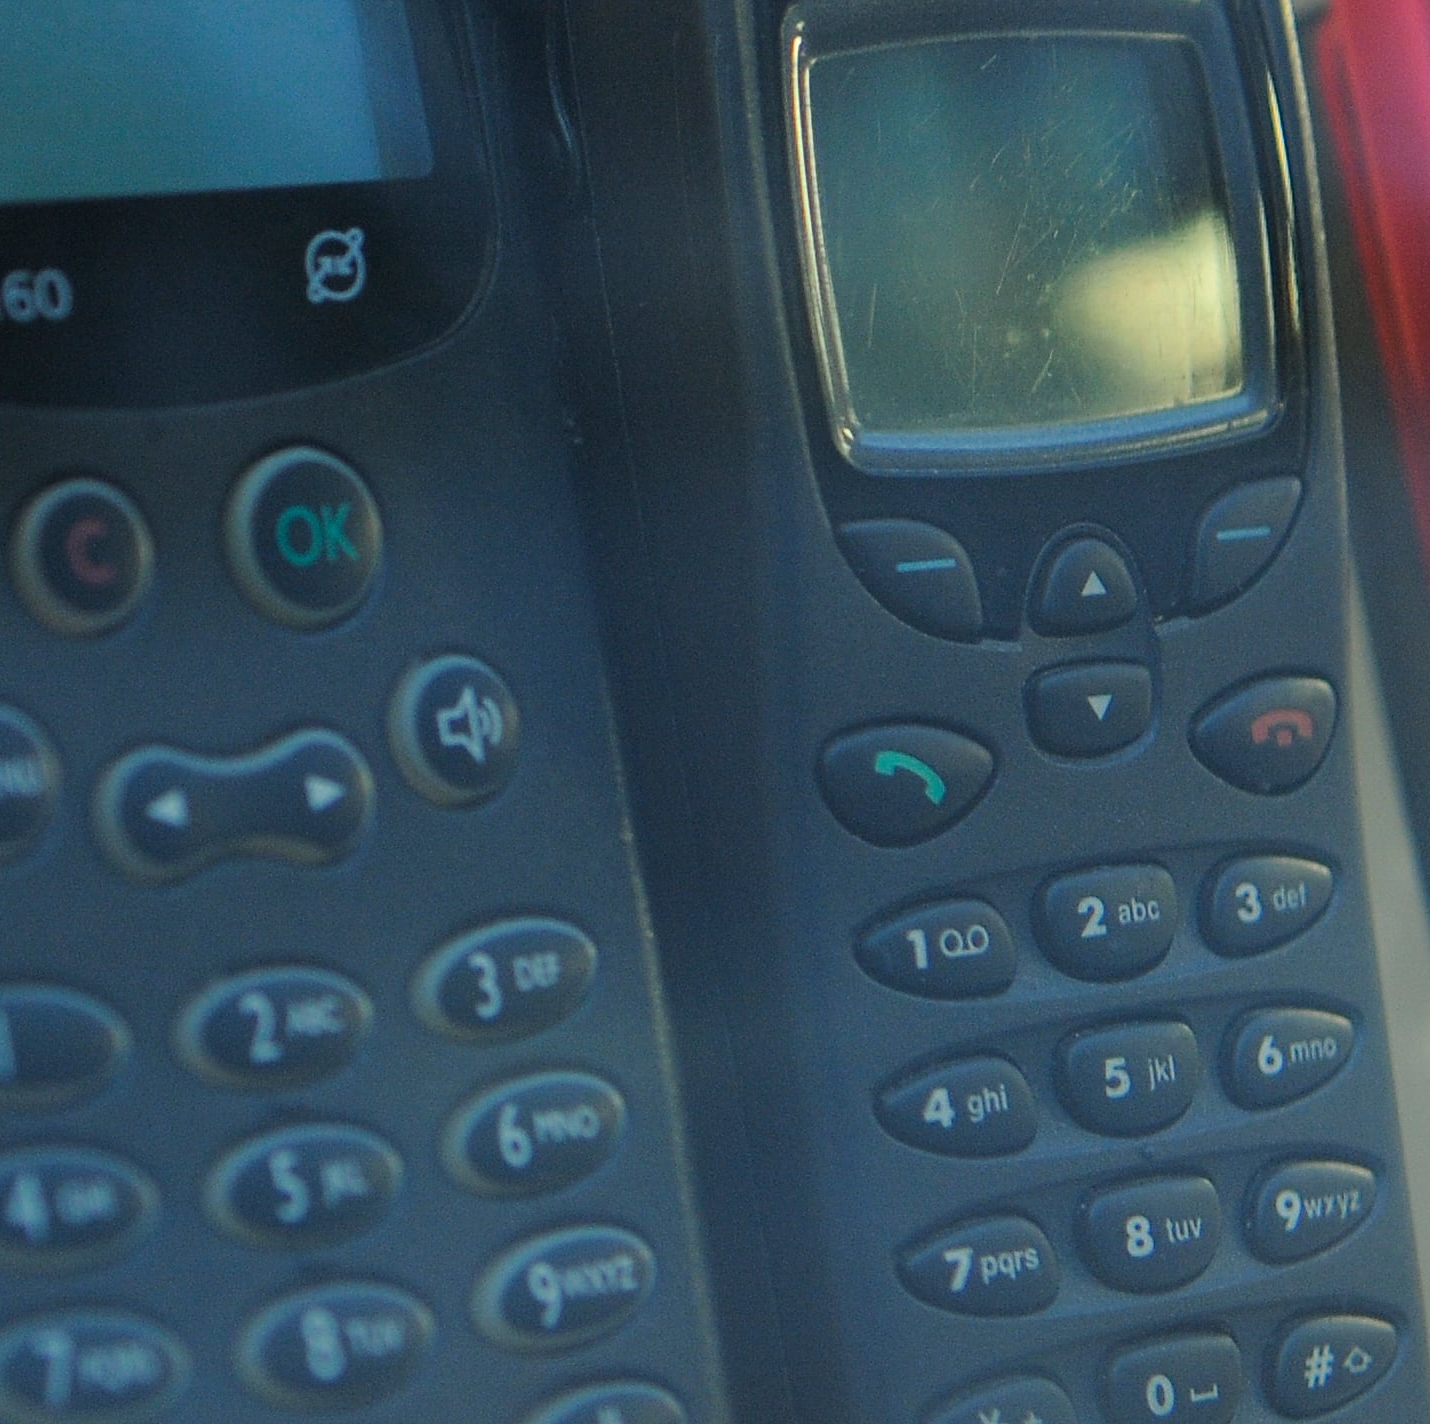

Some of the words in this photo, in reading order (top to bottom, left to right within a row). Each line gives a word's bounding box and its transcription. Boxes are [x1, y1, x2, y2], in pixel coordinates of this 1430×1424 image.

[66, 515, 114, 584] C
[275, 502, 359, 567] OK
[1077, 895, 1108, 938] 2
[1118, 897, 1161, 924] abc
[1235, 881, 1263, 923] 3
[1272, 882, 1307, 911] def
[906, 928, 930, 970] 1
[469, 951, 503, 1019] 3
[238, 992, 282, 1064] 2
[1103, 1056, 1131, 1099] 5
[1145, 1053, 1176, 1092] jkl
[1257, 1035, 1284, 1076] 6
[1288, 1035, 1338, 1063] mno
[923, 1086, 955, 1129] 4
[966, 1082, 1009, 1123] ghi
[498, 1102, 534, 1168] 6
[4, 1174, 48, 1242] 4
[269, 1147, 310, 1224] 5
[1124, 1214, 1154, 1258] 8
[1166, 1216, 1203, 1244] tuv
[1275, 1189, 1303, 1233] 9
[1303, 1190, 1362, 1225] wxyz
[944, 1247, 974, 1293] 7
[981, 1243, 1040, 1285] pqrs
[527, 1261, 563, 1329] 9
[35, 1328, 73, 1410] 7
[300, 1305, 348, 1383] 8
[1303, 1343, 1336, 1391] #
[1146, 1374, 1175, 1417] 0
